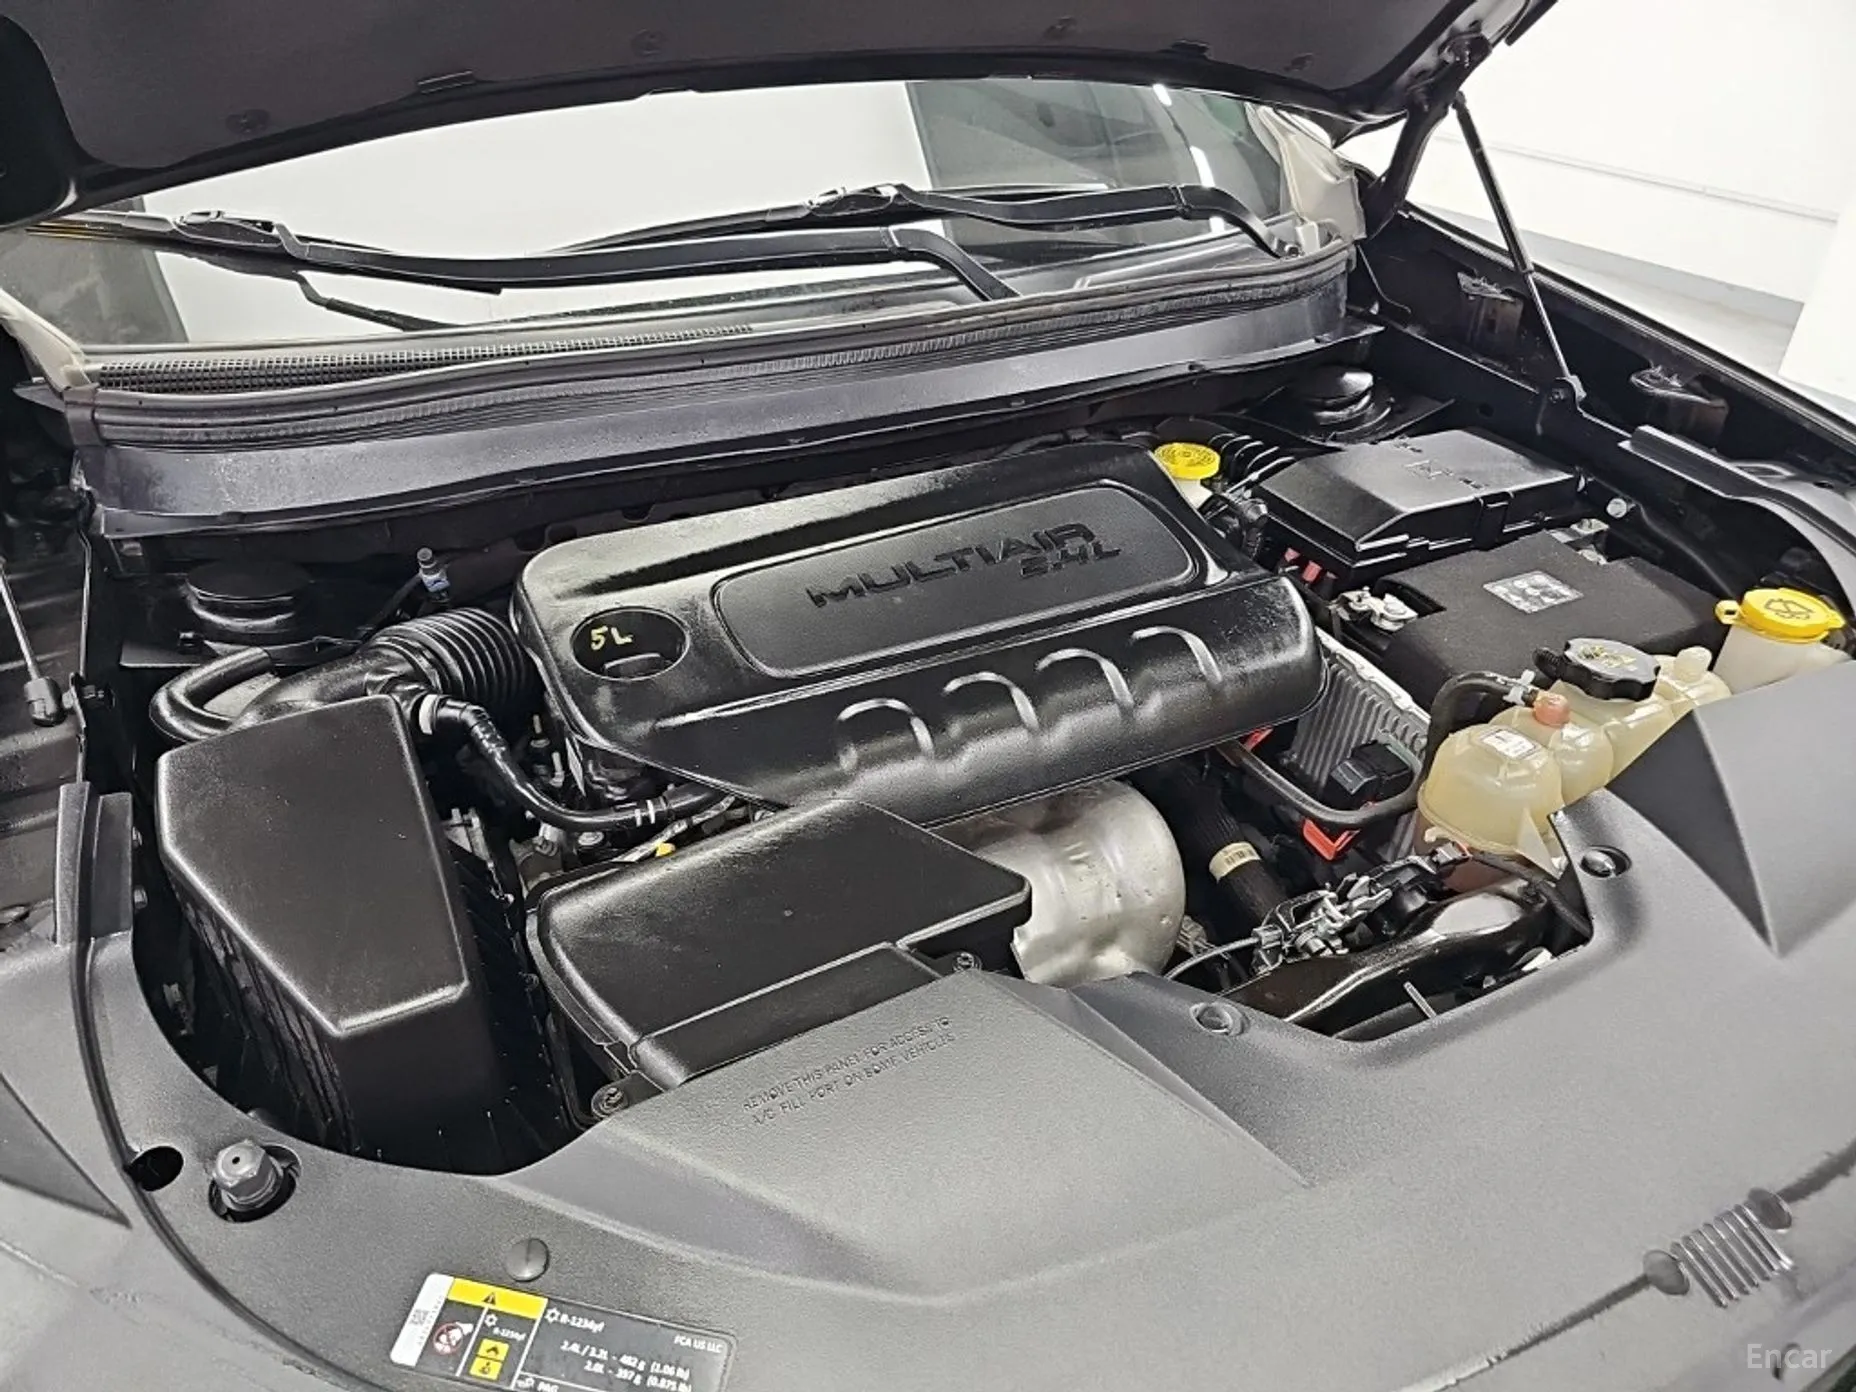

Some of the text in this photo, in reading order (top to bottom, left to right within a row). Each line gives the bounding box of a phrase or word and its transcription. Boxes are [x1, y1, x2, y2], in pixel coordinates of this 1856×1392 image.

[806, 523, 1096, 608] MULTIAIR
[742, 1082, 793, 1110] REMOVE
[793, 1068, 822, 1090] THIS
[863, 1042, 888, 1058] FOR
[844, 1072, 863, 1087] ON
[674, 1335, 724, 1353] FCA US LLC
